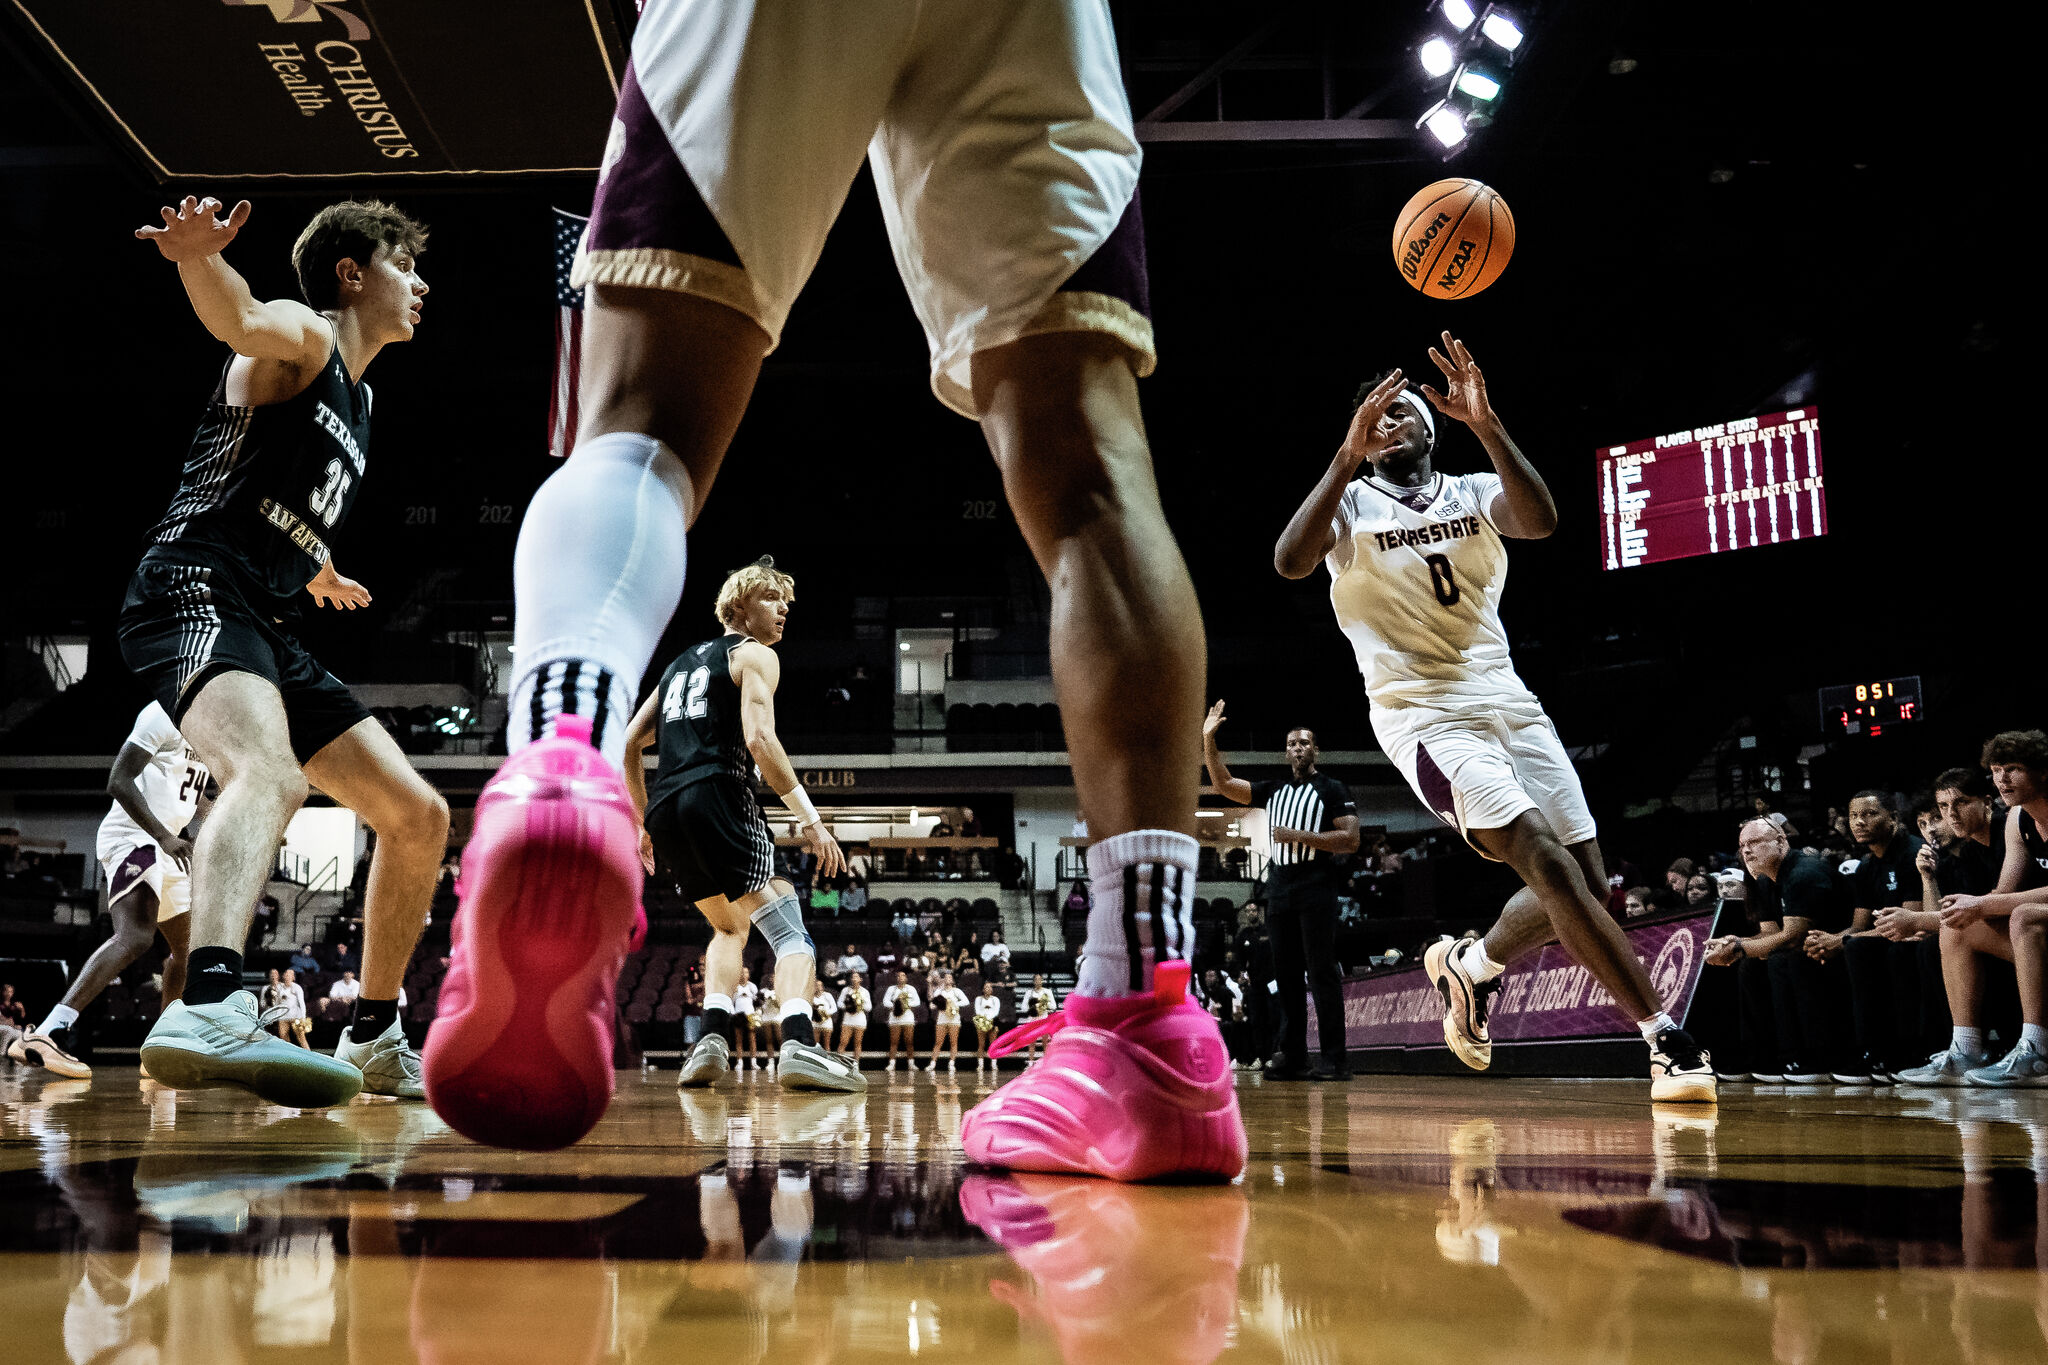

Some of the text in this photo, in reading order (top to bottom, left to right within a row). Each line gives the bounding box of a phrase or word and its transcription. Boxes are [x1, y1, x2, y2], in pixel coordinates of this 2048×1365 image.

[258, 42, 332, 110] Health
[315, 40, 419, 158] CHRISTUS
[1402, 212, 1452, 280] Wilson
[1438, 240, 1476, 290] NCAA
[1694, 424, 1725, 441] GAME
[1727, 417, 1758, 434] STATS
[1758, 426, 1777, 441] AST
[1778, 423, 1797, 437] STL
[308, 457, 352, 528] 35
[1762, 483, 1781, 498] AST
[1783, 480, 1801, 494] STL
[259, 498, 300, 533] SAN
[405, 506, 437, 524] 201
[480, 505, 513, 524] 202
[962, 499, 997, 519] 202
[1374, 516, 1480, 552] TEXAS STATE
[1424, 553, 1460, 607] 0
[662, 665, 711, 723] 42
[180, 767, 206, 805] 24
[803, 770, 856, 787] CLUB
[1499, 973, 1533, 1014] THE
[1525, 965, 1590, 1012] BOBCAT
